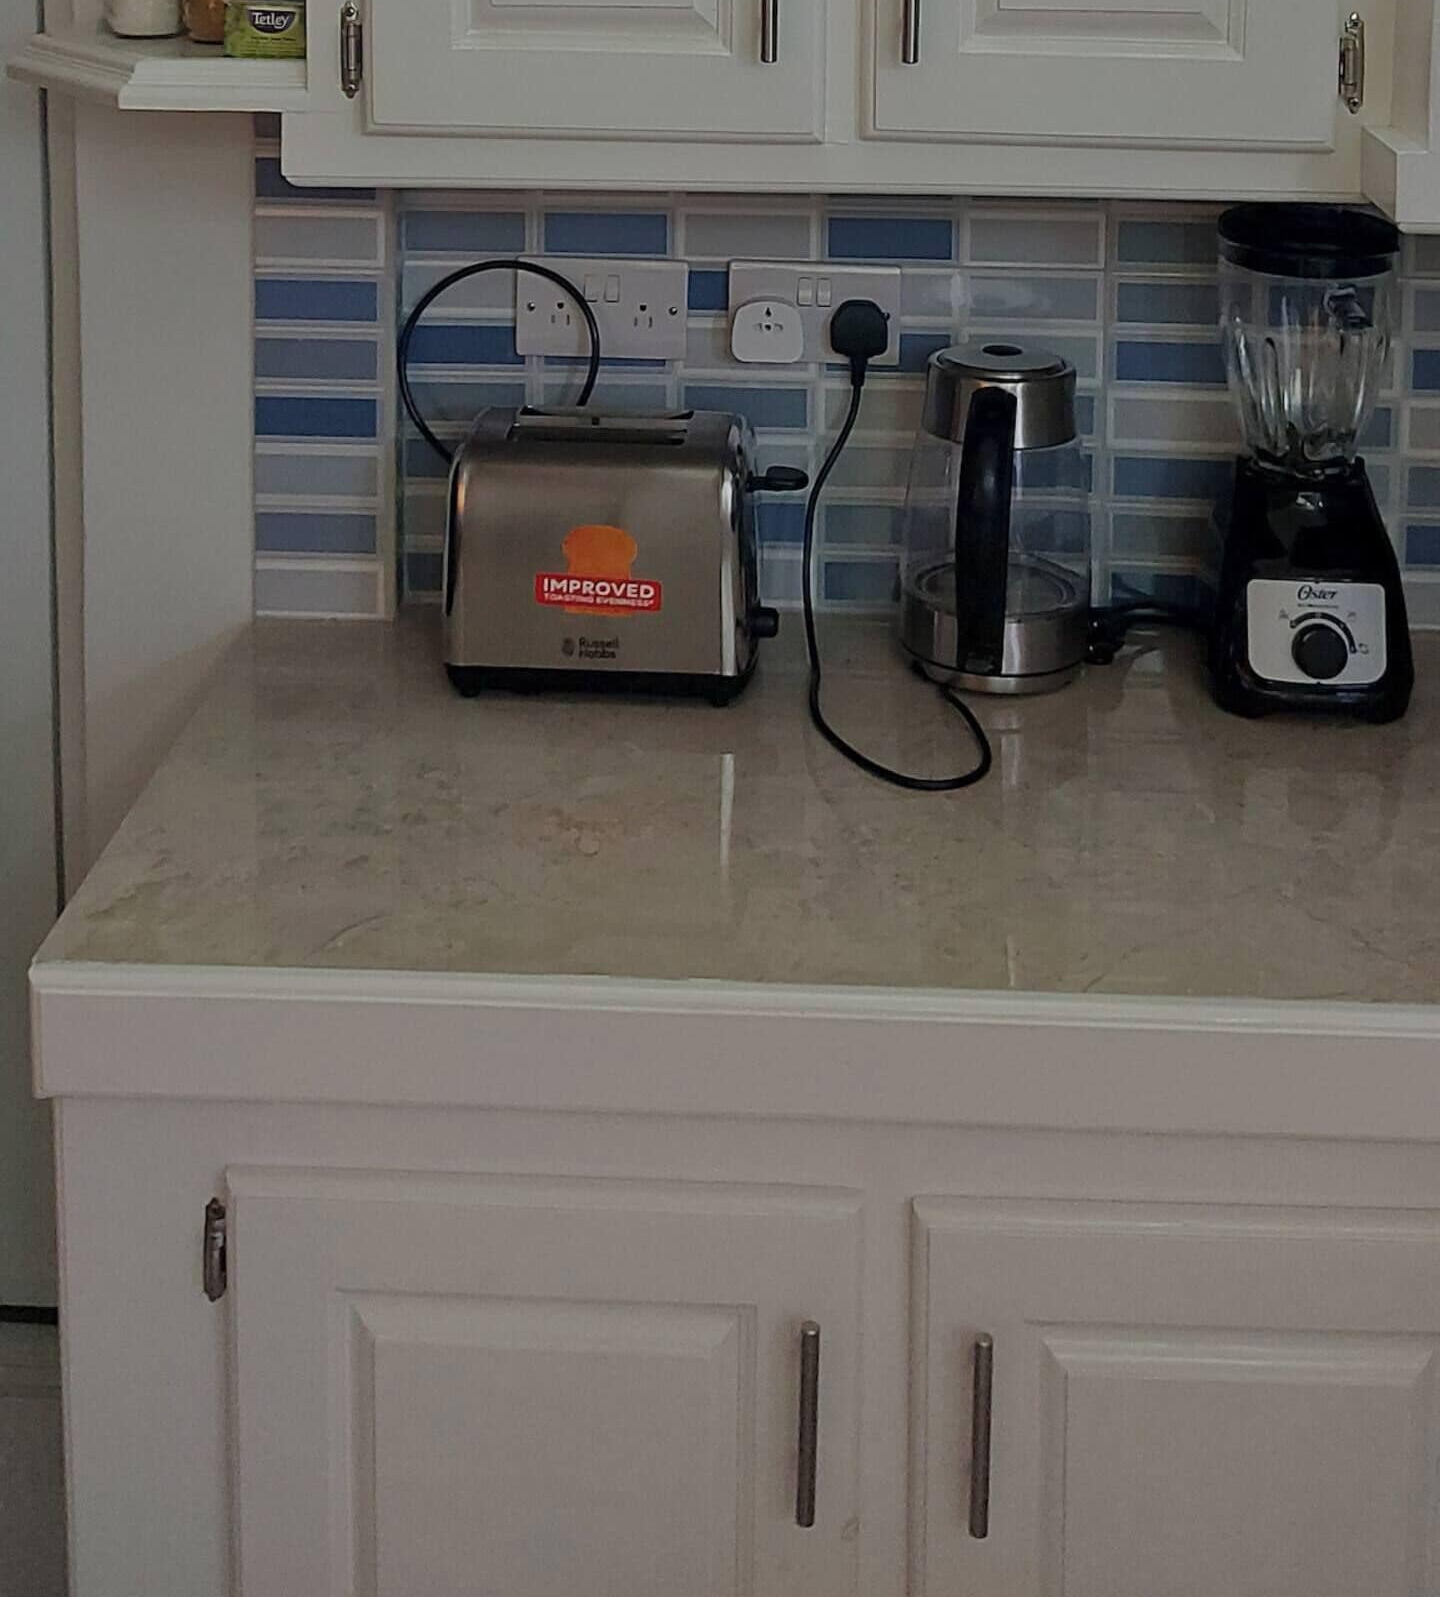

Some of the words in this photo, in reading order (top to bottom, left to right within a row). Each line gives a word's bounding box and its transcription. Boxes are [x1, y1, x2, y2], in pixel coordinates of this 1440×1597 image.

[252, 12, 290, 29] Tetley
[543, 577, 655, 599] IMPROVED
[1297, 584, 1338, 601] Oster
[578, 636, 620, 650] Russell
